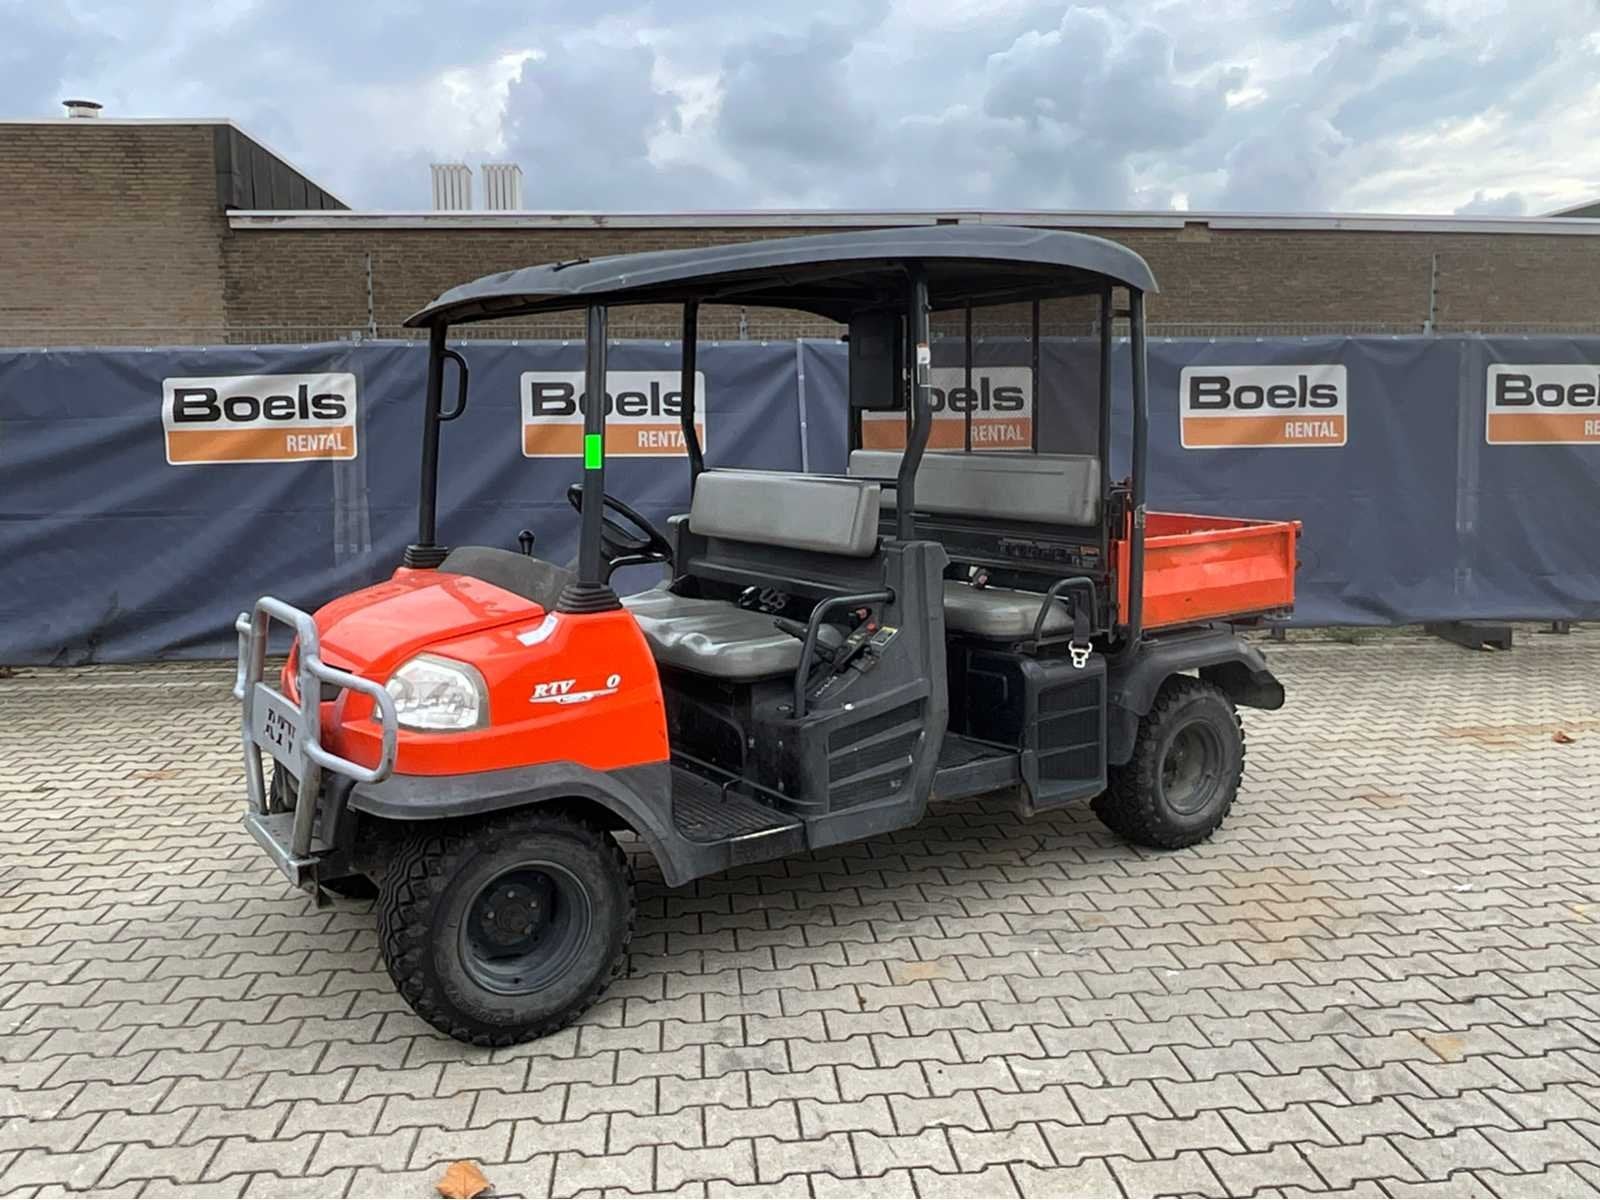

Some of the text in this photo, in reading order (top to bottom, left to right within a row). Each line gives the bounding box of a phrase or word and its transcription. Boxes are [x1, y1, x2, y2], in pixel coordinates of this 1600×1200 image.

[929, 376, 1025, 412] els
[1190, 375, 1339, 410] Boels
[173, 384, 347, 423] Boels
[638, 430, 688, 448] RENTA
[970, 425, 1025, 442] RENTAL
[1284, 421, 1338, 438] RENTAL
[287, 433, 347, 452] RENTAL
[532, 679, 577, 698] RTV
